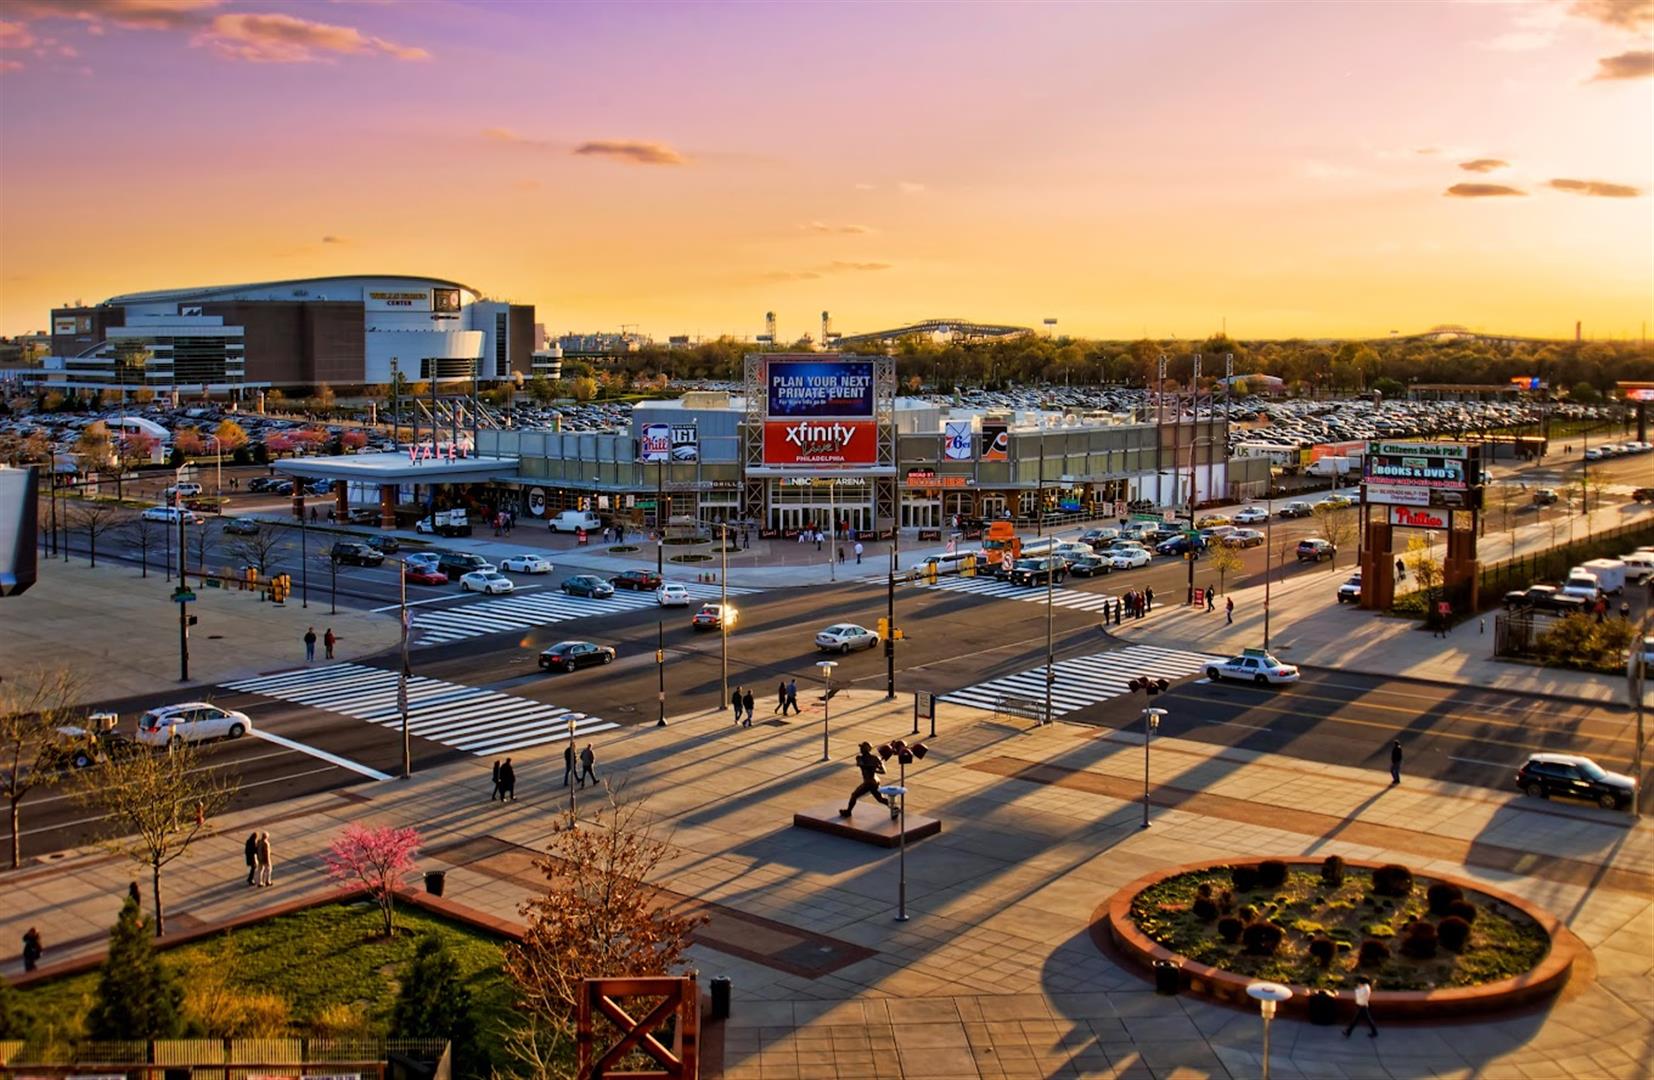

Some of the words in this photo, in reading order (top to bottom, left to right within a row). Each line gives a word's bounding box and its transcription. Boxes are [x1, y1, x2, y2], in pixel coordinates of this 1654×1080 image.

[773, 376, 803, 387] PLAN
[807, 376, 837, 387] YOUR
[841, 376, 871, 387] NEXT
[778, 387, 830, 398] PRIVATE
[830, 387, 866, 398] EVENT
[785, 422, 856, 446] xfinity
[409, 441, 468, 461] VALET
[802, 439, 840, 456] Live!
[1383, 445, 1418, 454] Citizens
[1419, 446, 1441, 455] Bank
[1443, 447, 1463, 457] Park
[1377, 466, 1412, 476] BOOKS
[1413, 469, 1421, 477] &
[1423, 468, 1455, 479] DVD'S
[791, 478, 812, 486] NBC
[836, 478, 866, 486] ARENA
[1395, 506, 1443, 526] Phillies
